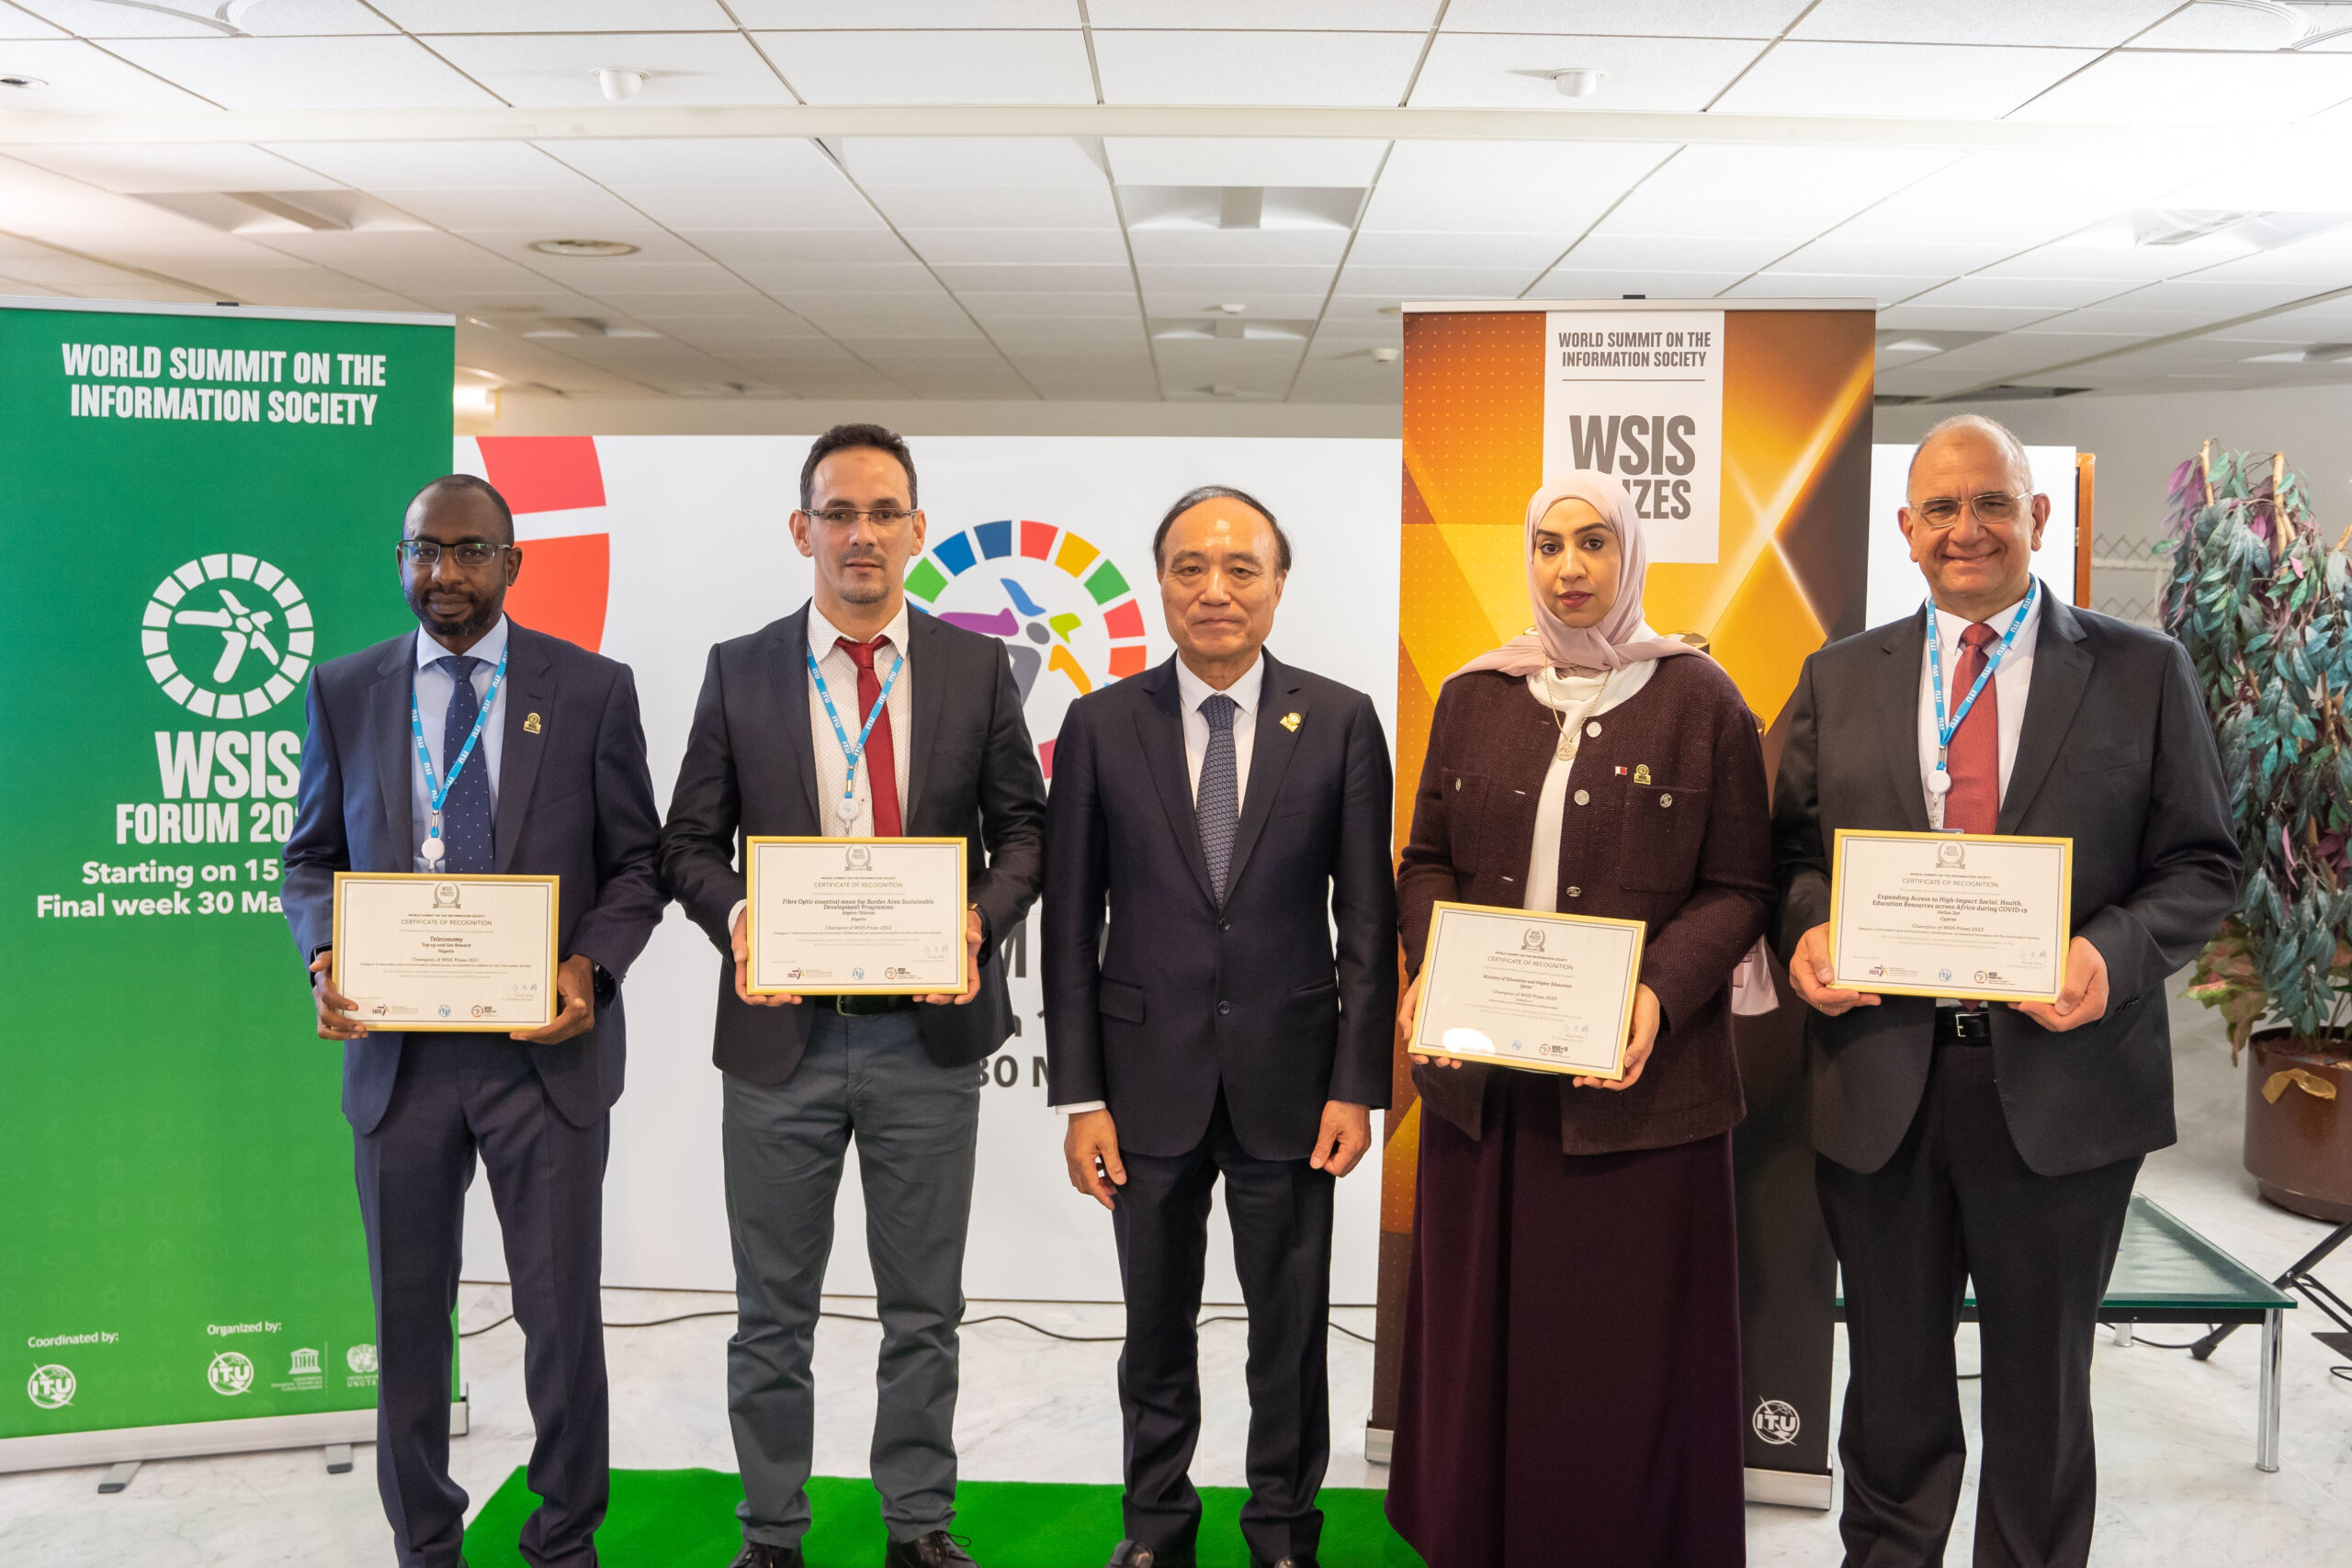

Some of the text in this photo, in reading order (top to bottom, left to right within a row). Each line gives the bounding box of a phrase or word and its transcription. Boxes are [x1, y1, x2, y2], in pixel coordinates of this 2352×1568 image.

[1558, 332, 1711, 347] WORLD SUMMIT ON THE
[62, 343, 386, 387] WORLD SUMMIT ON THE
[1562, 352, 1706, 367] INFORMATION SOCIETY
[71, 384, 379, 425] INFORMATION SOCIETY
[1569, 415, 1696, 476] WSIS
[1622, 479, 1691, 520] ZES
[154, 730, 301, 799] WSIS
[117, 803, 239, 844] FORUM
[82, 859, 279, 889] Starting on 15
[37, 890, 285, 918] Final week 30 Ma
[1939, 897, 1977, 905] High-Impact
[1487, 956, 1521, 964] CERTIFICATE
[1532, 961, 1573, 970] RECOGNITION
[28, 1331, 119, 1348] Coordinated by:
[207, 1320, 281, 1337] Organized by:
[347, 1380, 378, 1388] UNCTA
